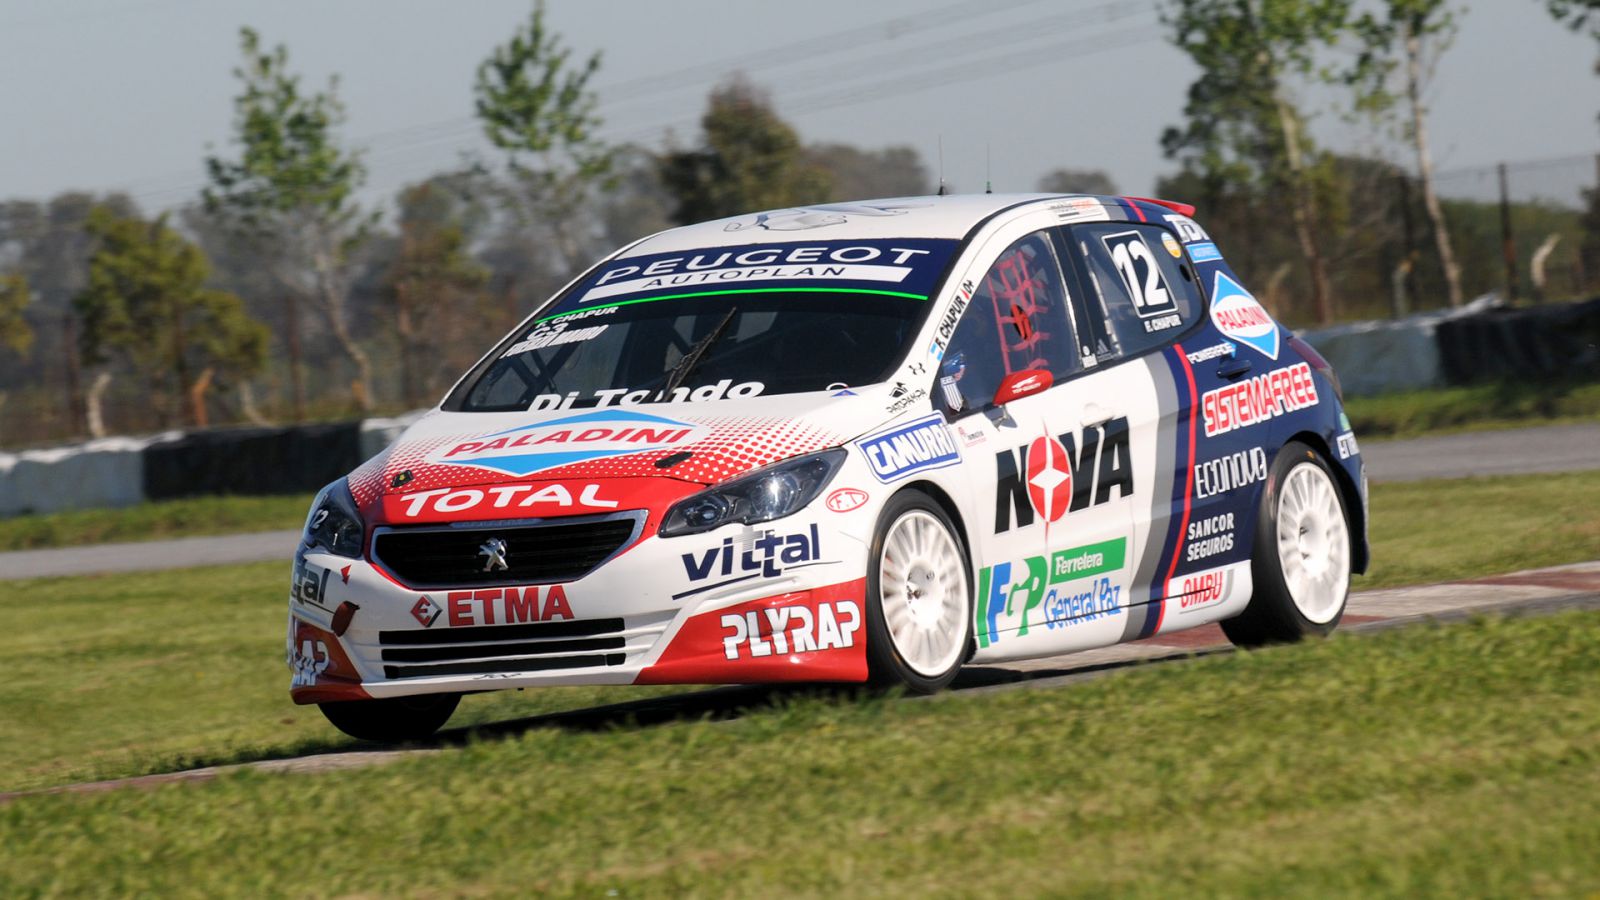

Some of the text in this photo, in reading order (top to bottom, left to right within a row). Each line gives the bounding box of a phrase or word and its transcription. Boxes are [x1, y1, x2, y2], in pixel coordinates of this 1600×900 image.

[596, 247, 930, 286] PEUGEOT
[641, 267, 847, 289] AUTOPLAN
[1112, 239, 1169, 308] 12
[551, 306, 619, 324] CHAPUR
[940, 295, 966, 339] CHAPUR
[1214, 305, 1271, 332] PALADINI
[1203, 363, 1318, 436] SISTEMAFREE
[443, 428, 693, 458] PALADINI
[865, 423, 956, 476] CAMURRI
[994, 415, 1135, 534] NOVA
[400, 483, 618, 517] TOTAL
[1188, 512, 1235, 540] SANCOR
[681, 523, 820, 579] vittal
[1055, 551, 1104, 576] Ferretera
[1187, 532, 1235, 562] SEGUROS
[447, 584, 575, 627] ETMA
[1043, 577, 1122, 631] General Paz
[1180, 570, 1224, 609] OMBU
[720, 600, 861, 660] PLYRAP
